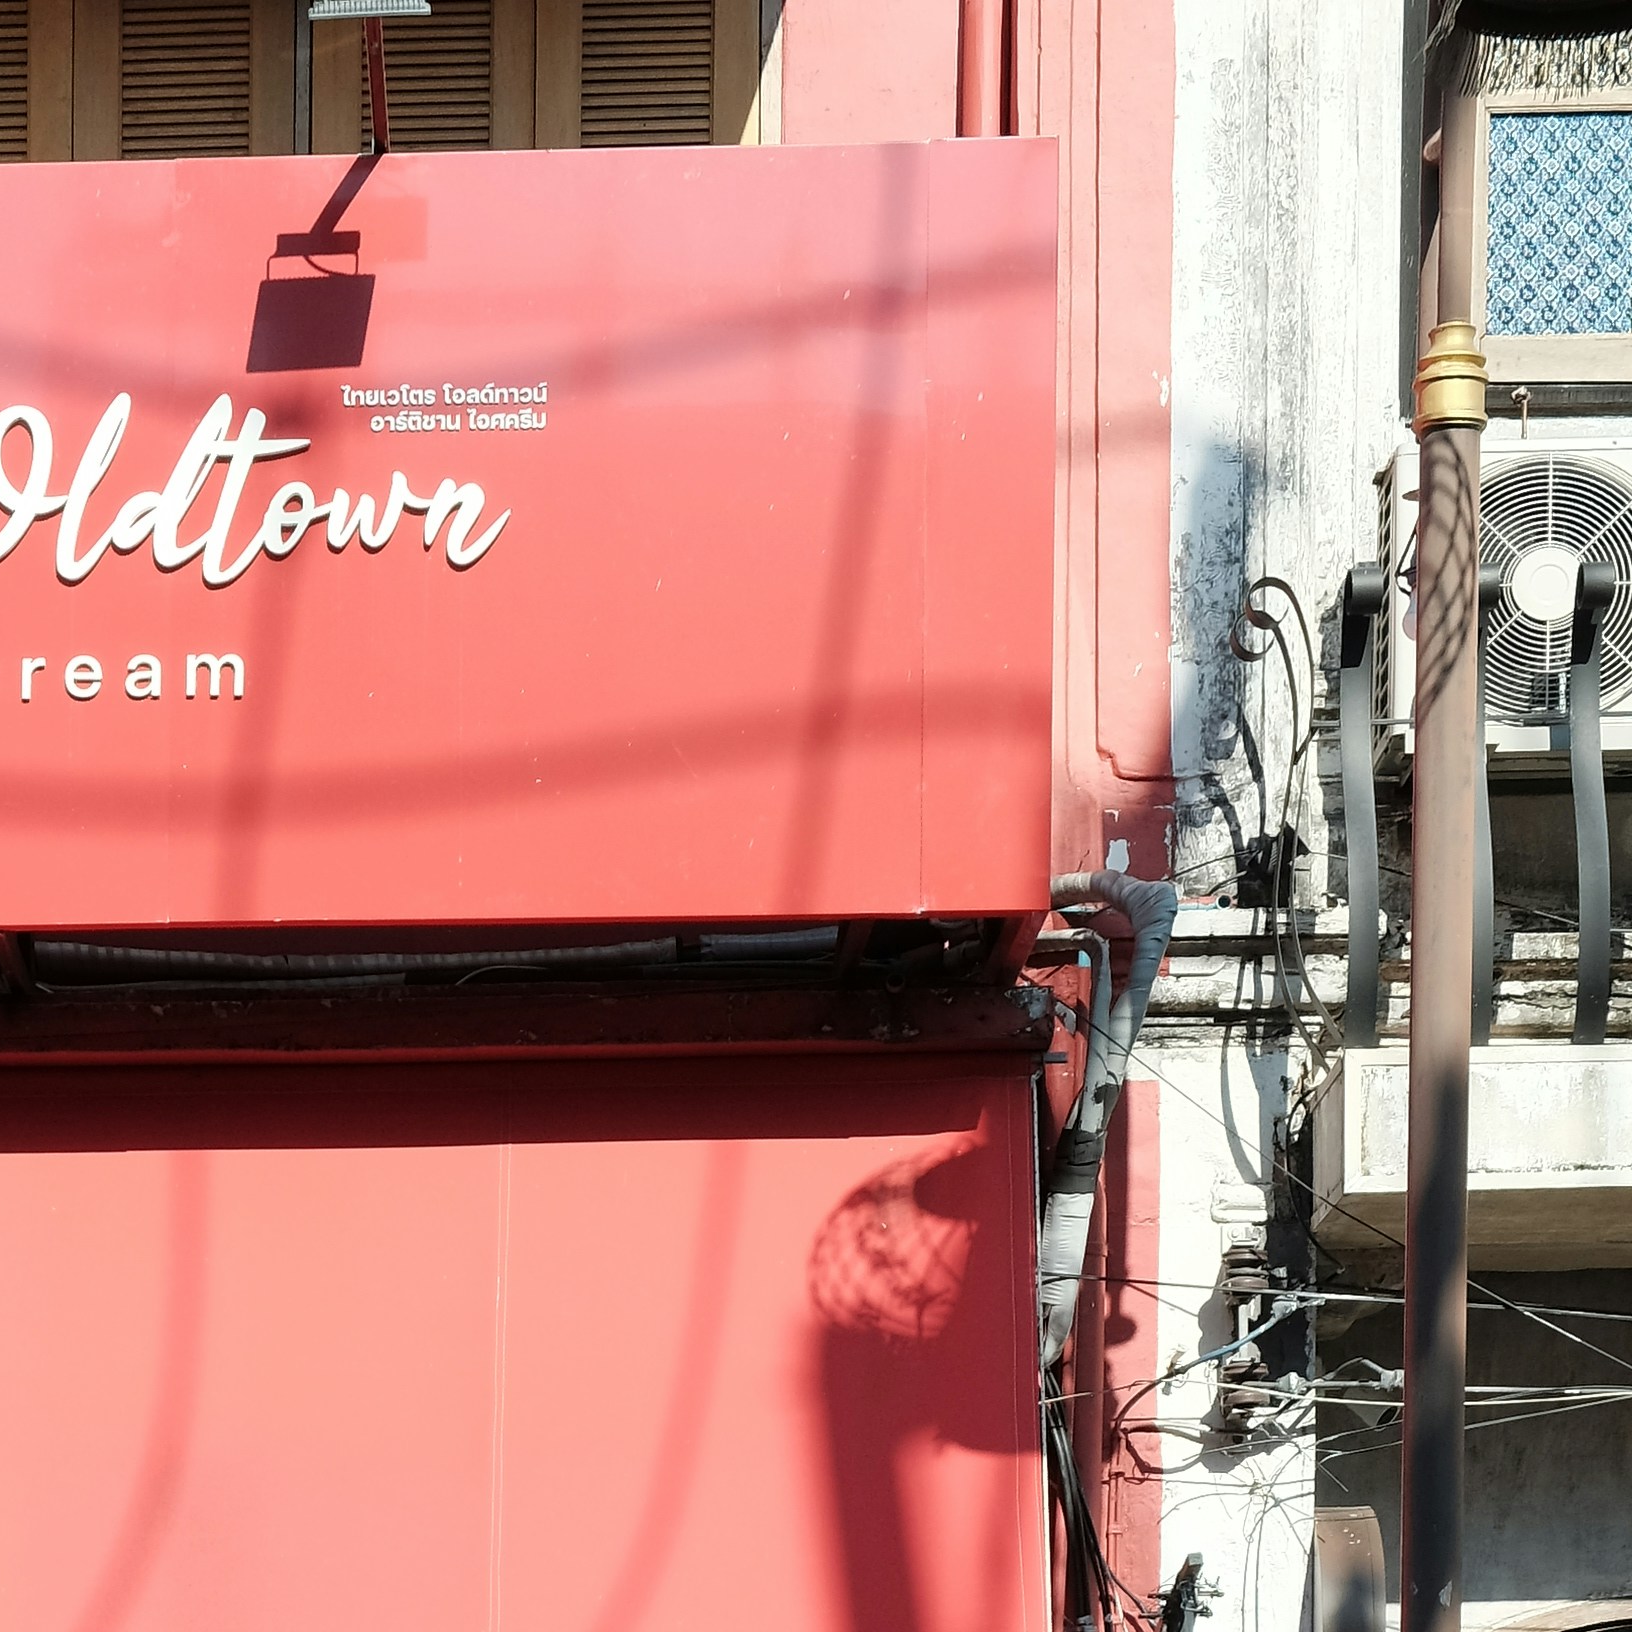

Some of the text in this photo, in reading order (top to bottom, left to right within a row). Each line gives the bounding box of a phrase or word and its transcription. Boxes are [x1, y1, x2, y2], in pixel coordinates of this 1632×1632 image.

[341, 381, 548, 407] ไทยเวโตร โอลด์ทาวน์
[370, 409, 461, 432] อาร์ติชาน
